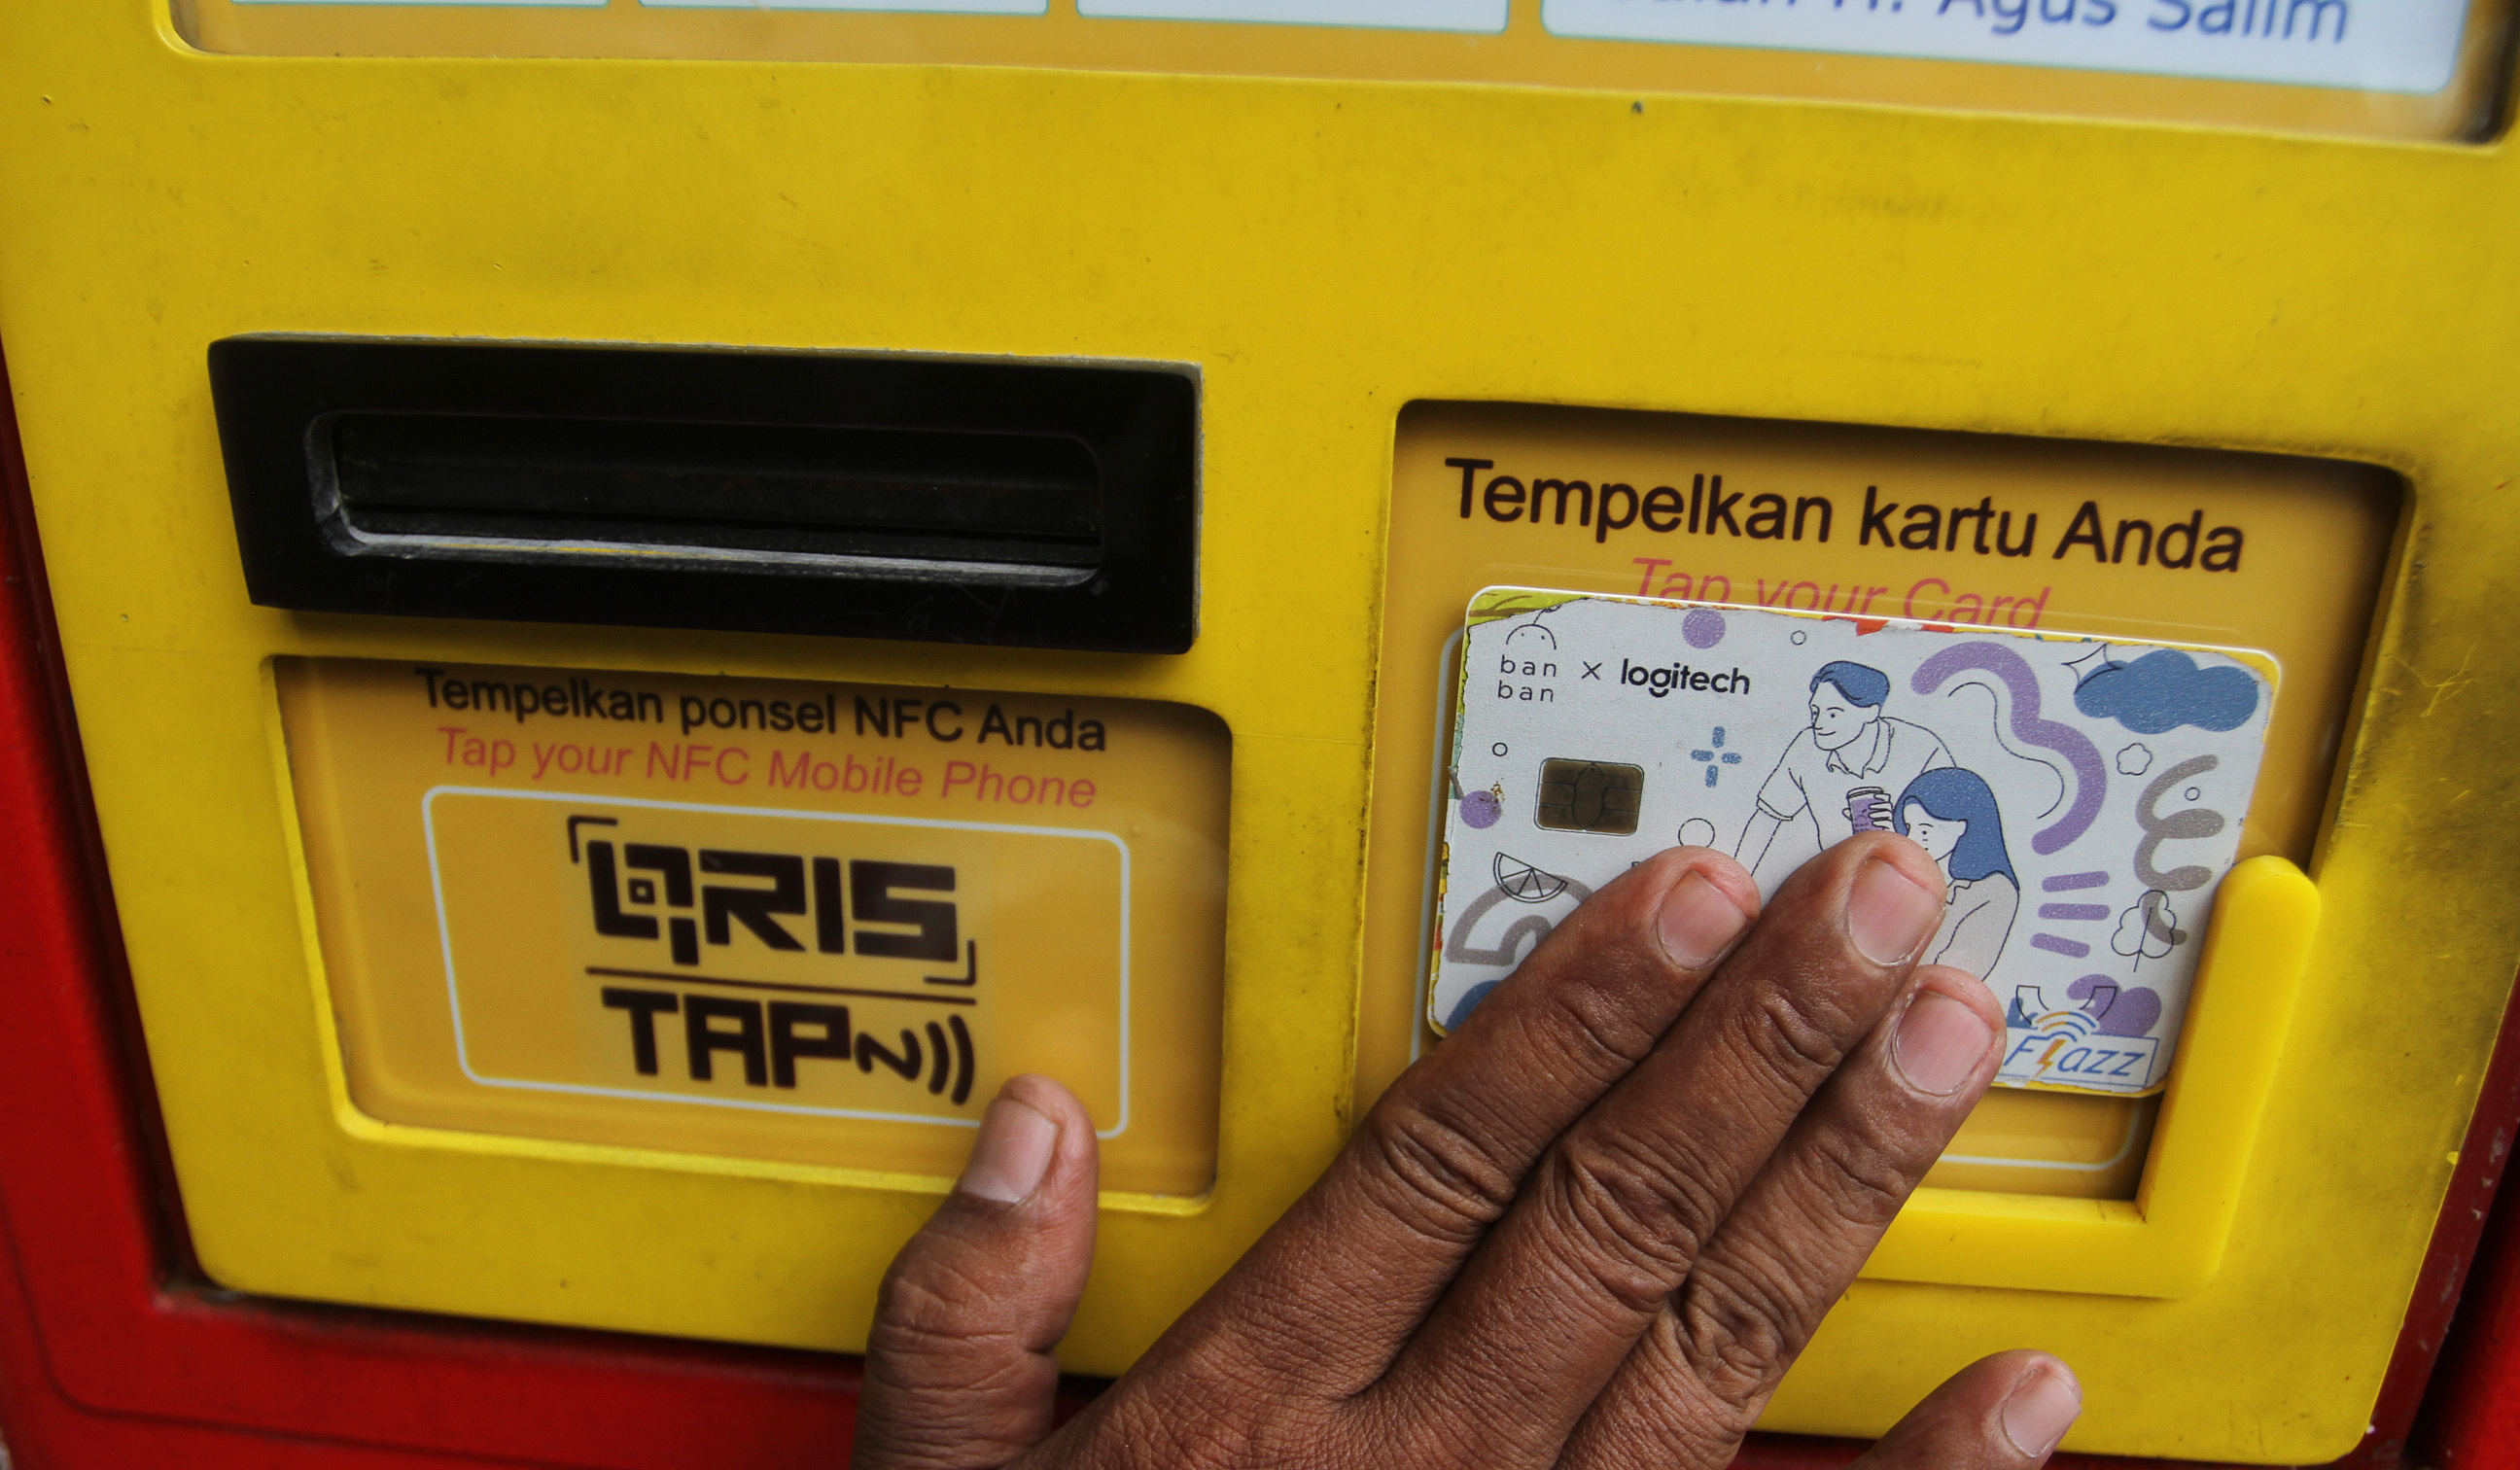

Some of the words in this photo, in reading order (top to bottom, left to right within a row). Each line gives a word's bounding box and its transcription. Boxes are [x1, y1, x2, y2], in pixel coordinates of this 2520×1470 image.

[1445, 458, 1832, 543] Tempelkan
[1859, 485, 2038, 558] kartu
[2051, 500, 2244, 573] Anda
[1903, 578, 2051, 632] Card
[415, 668, 664, 723] Tempelkan
[681, 693, 836, 736] ponsel
[854, 695, 963, 742] NFC
[976, 704, 1107, 752] Anda
[1497, 681, 1555, 702] ban
[1500, 654, 1557, 678] ban
[1621, 658, 1750, 698] logitech
[438, 726, 516, 778] Tap
[531, 742, 633, 781] your
[646, 741, 751, 787] NFC
[766, 749, 924, 798] Mobile
[940, 759, 1098, 809] Phone
[585, 839, 960, 966] QRIS
